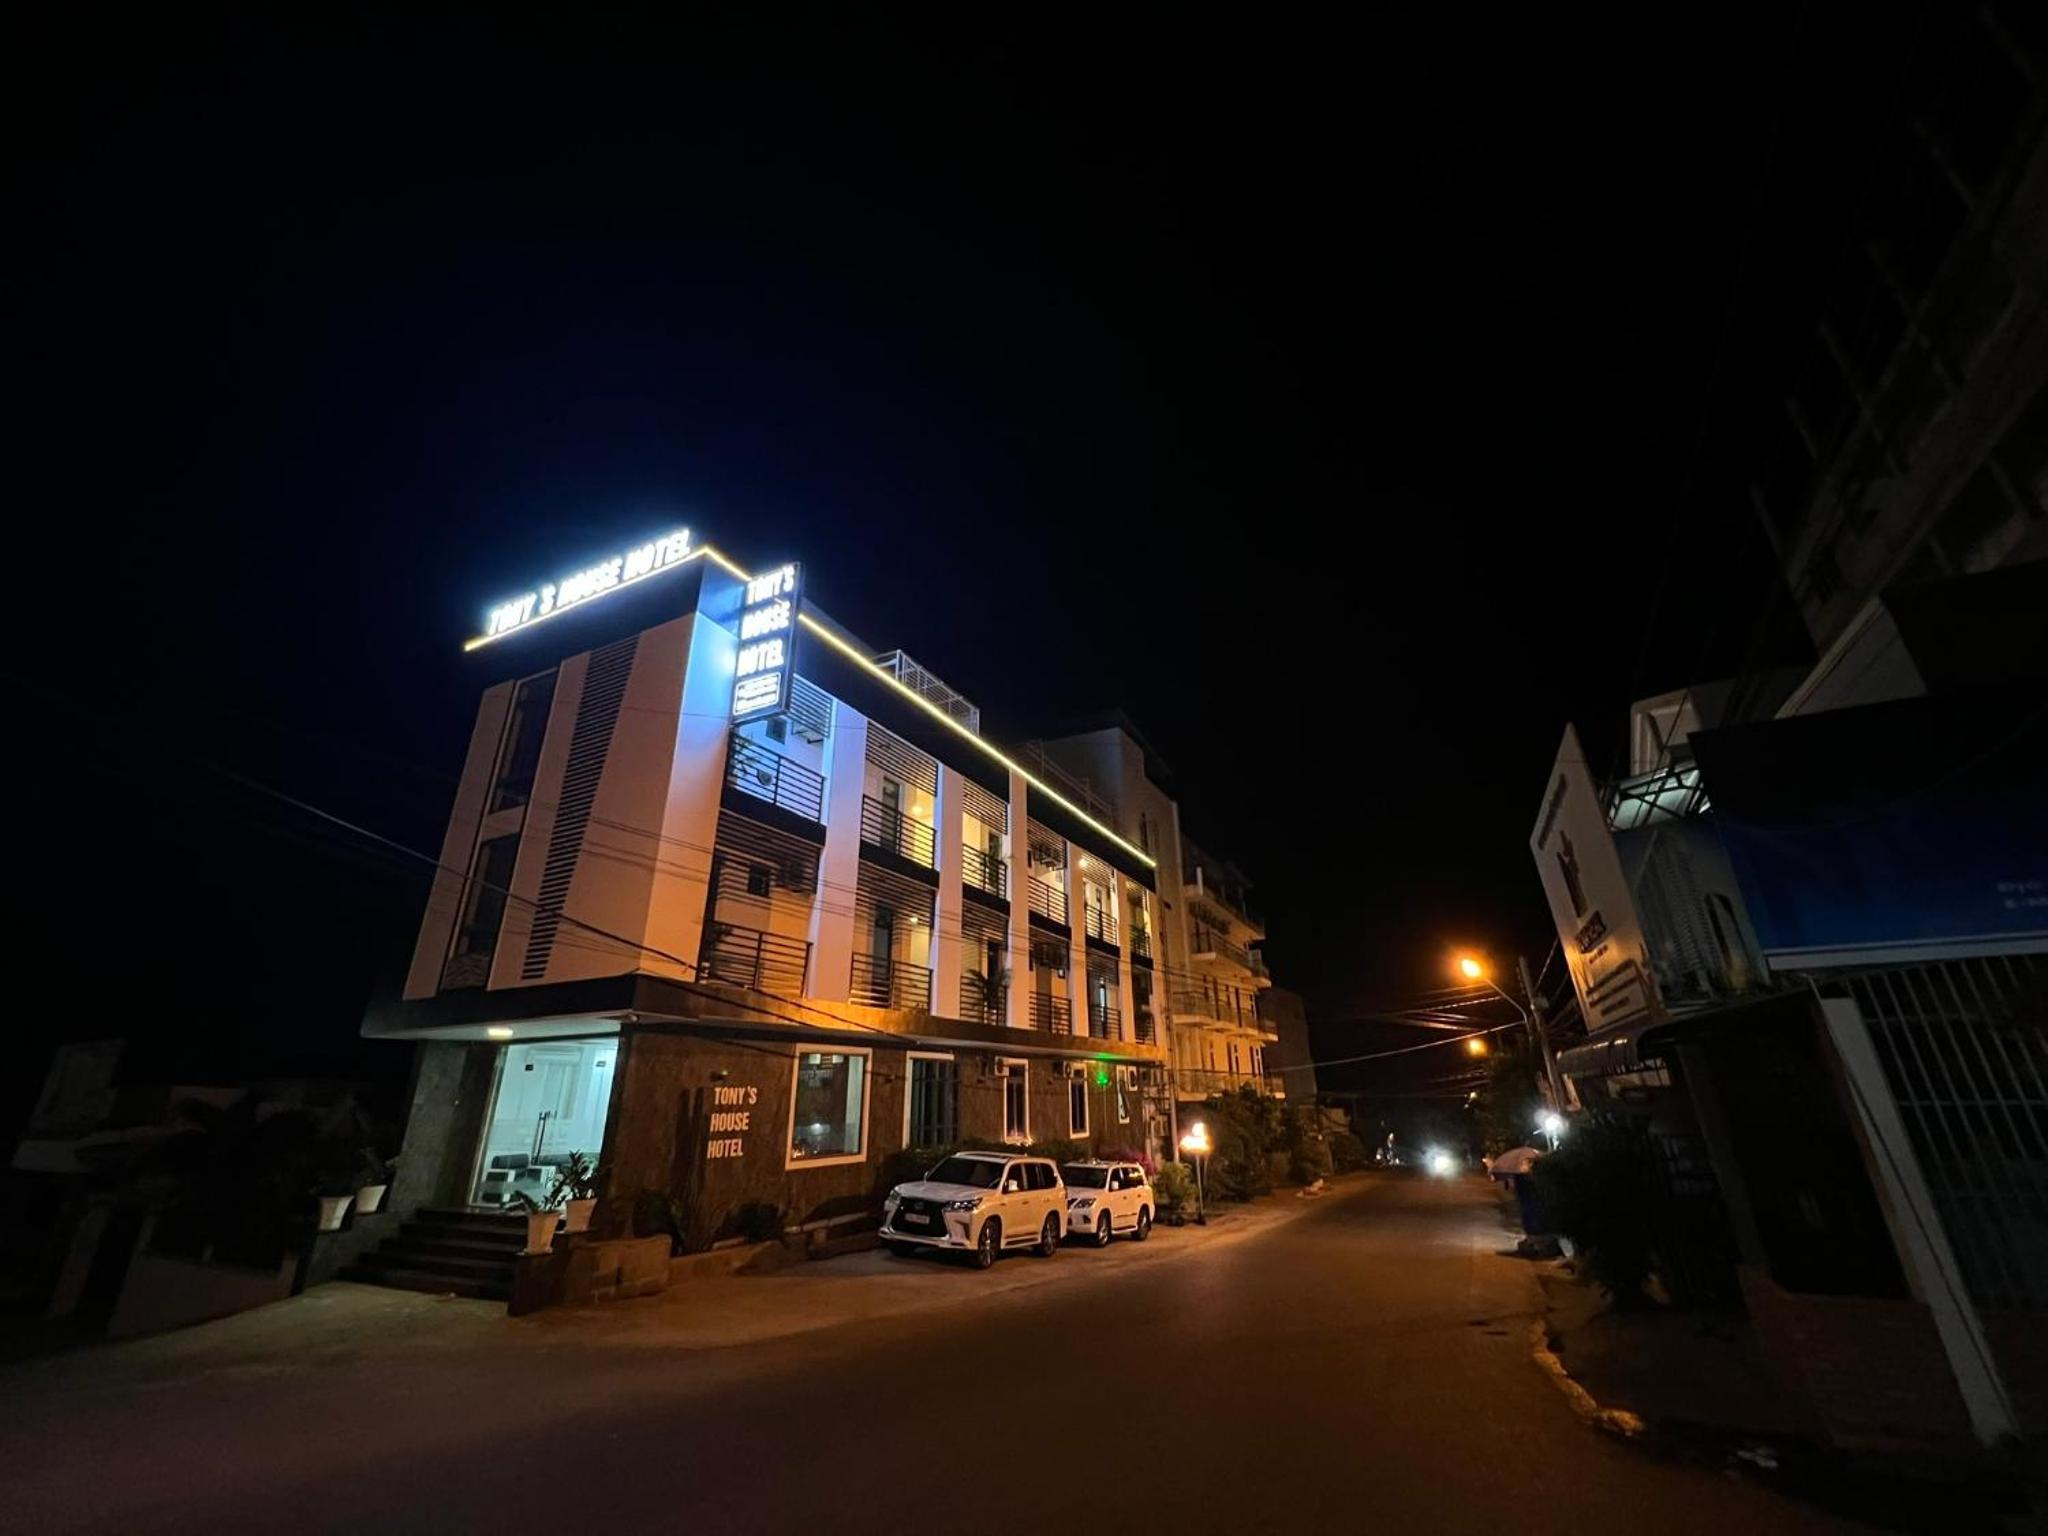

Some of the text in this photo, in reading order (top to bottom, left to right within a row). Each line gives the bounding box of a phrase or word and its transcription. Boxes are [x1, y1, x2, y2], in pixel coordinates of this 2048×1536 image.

[623, 529, 690, 581] HOTEL
[737, 639, 784, 677] HOTEL
[714, 1086, 757, 1105] TONY'S
[710, 1112, 750, 1131] HOUSE
[707, 1139, 743, 1159] HOTEL
